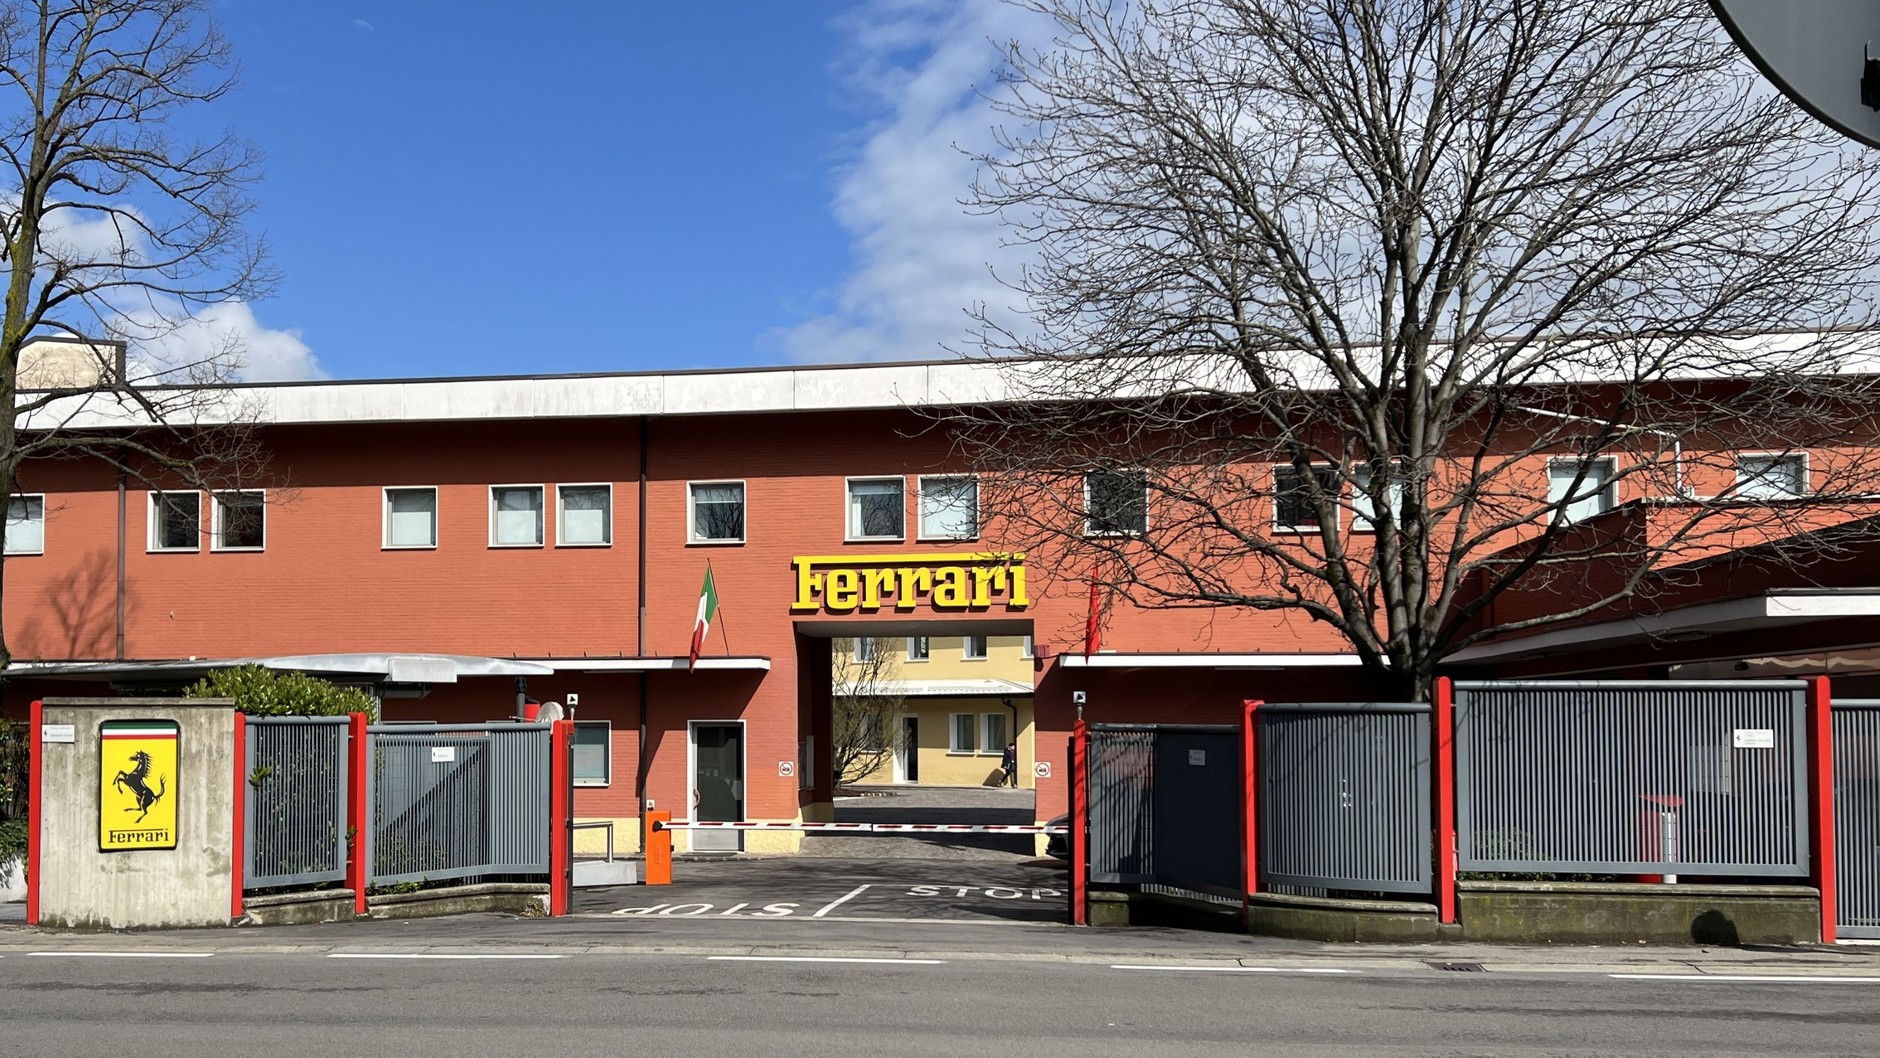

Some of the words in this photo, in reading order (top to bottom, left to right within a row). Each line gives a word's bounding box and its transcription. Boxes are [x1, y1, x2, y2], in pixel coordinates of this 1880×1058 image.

[792, 552, 1029, 611] Ferrari
[108, 828, 169, 843] Ferrari
[905, 885, 1062, 900] STOP
[611, 902, 801, 917] STOP
